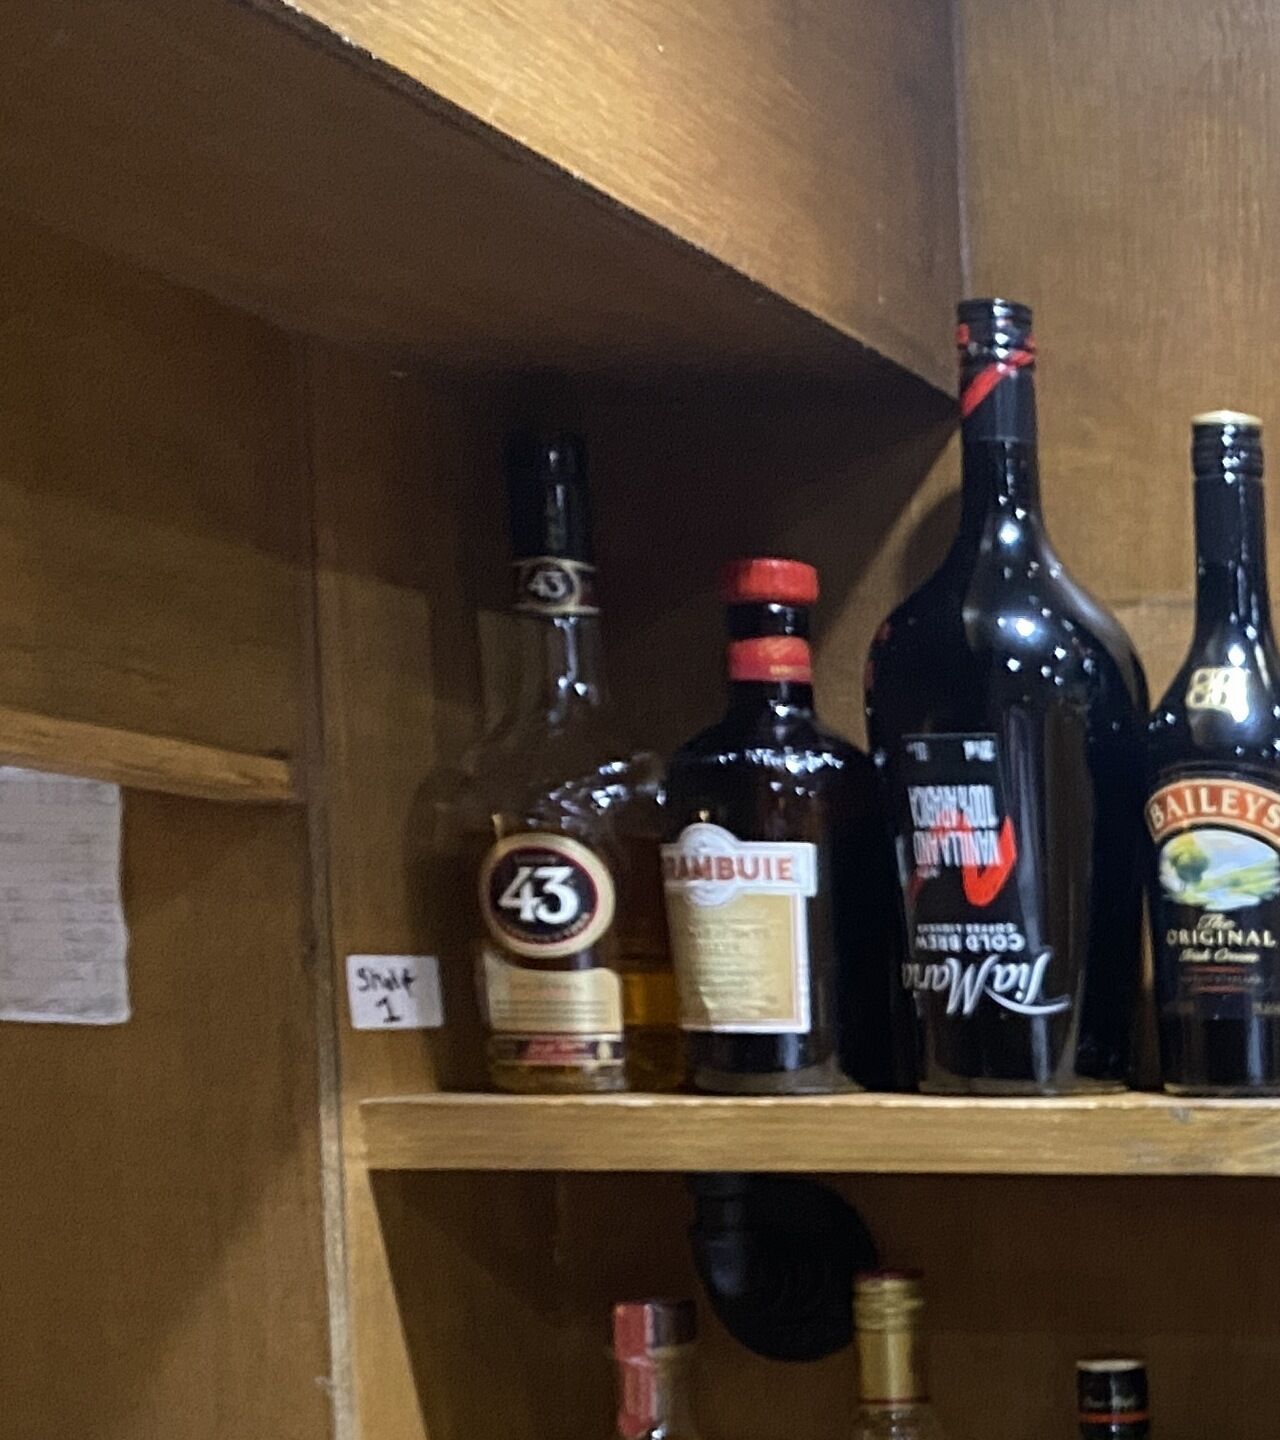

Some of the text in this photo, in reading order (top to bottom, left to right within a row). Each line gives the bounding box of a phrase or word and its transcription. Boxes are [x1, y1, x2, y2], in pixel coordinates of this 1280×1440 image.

[497, 864, 580, 926] 43
[966, 932, 1026, 952] COLD
[1166, 929, 1277, 948] ORIGINAL
[374, 996, 402, 1023] 1
